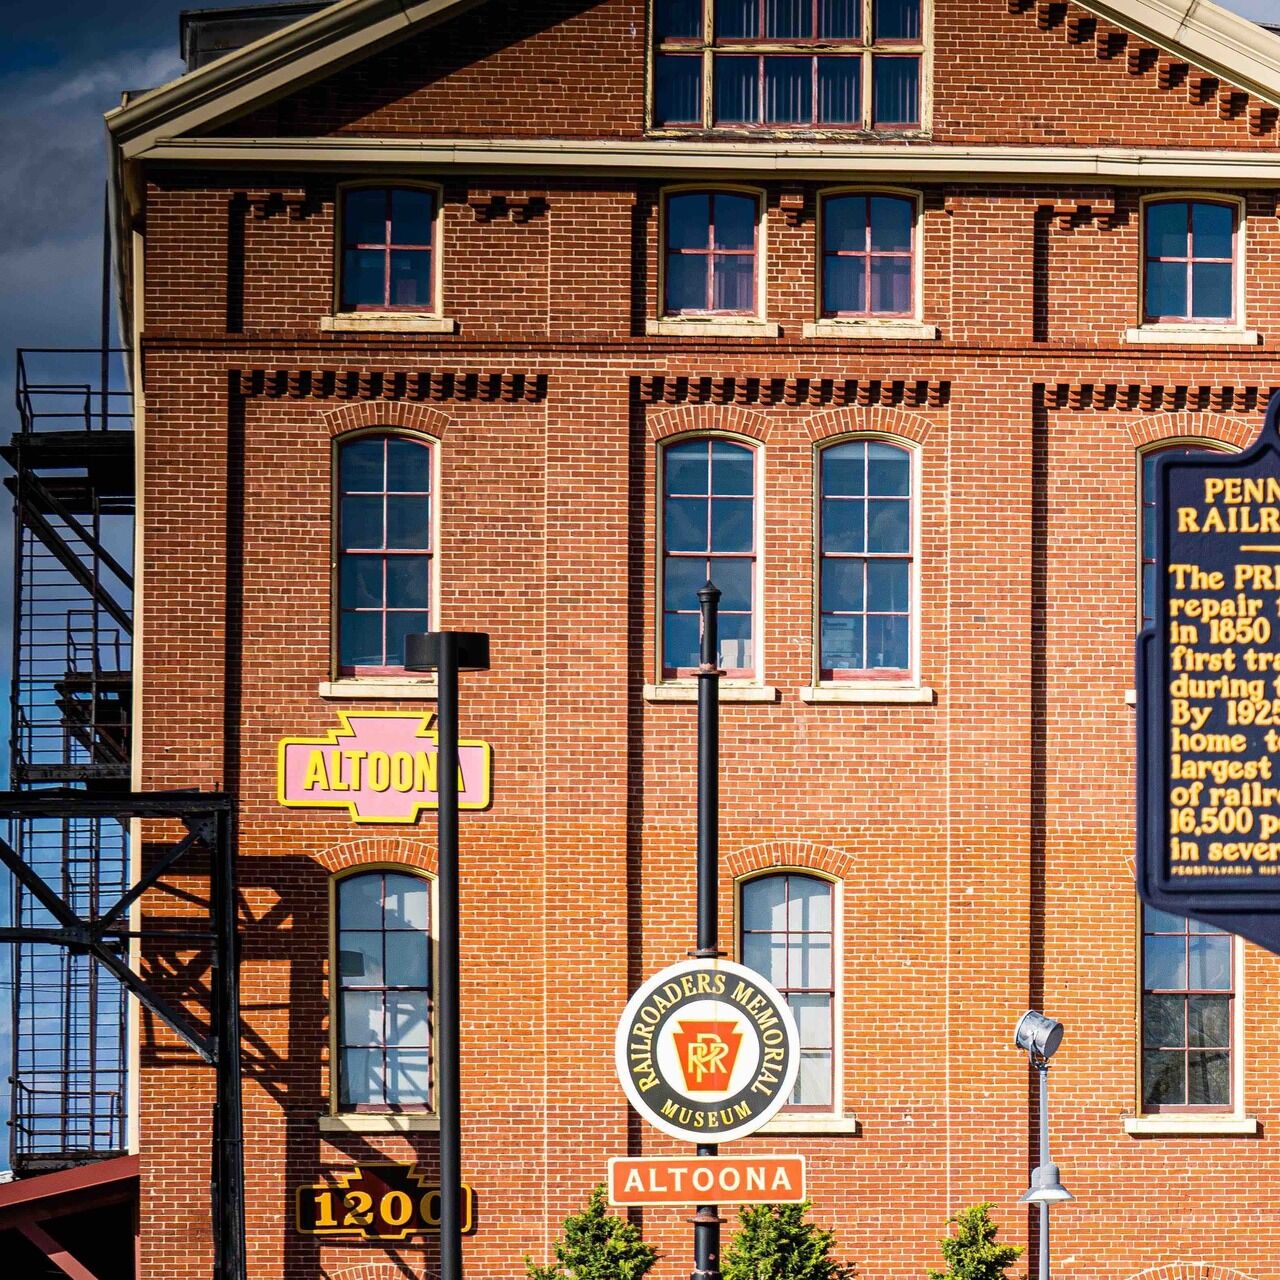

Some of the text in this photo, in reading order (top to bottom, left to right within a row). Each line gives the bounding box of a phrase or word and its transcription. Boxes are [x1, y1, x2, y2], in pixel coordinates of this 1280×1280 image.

[1169, 564, 1224, 590] The
[1170, 594, 1263, 621] repair
[1171, 621, 1197, 643] in
[1209, 618, 1270, 644] 1850
[1172, 645, 1235, 671] first
[1171, 673, 1268, 702] during
[1172, 700, 1212, 729] By
[1172, 728, 1246, 752] home
[1171, 755, 1271, 783] largest
[1171, 781, 1203, 806] of
[1171, 807, 1253, 835] 16,500
[1171, 838, 1199, 861] in
[631, 973, 785, 1097] RAILROADERS MEMORIAL
[661, 1099, 753, 1128] MUSEUM
[624, 1167, 792, 1192] ALTOONA
[314, 1191, 441, 1226] 1200
